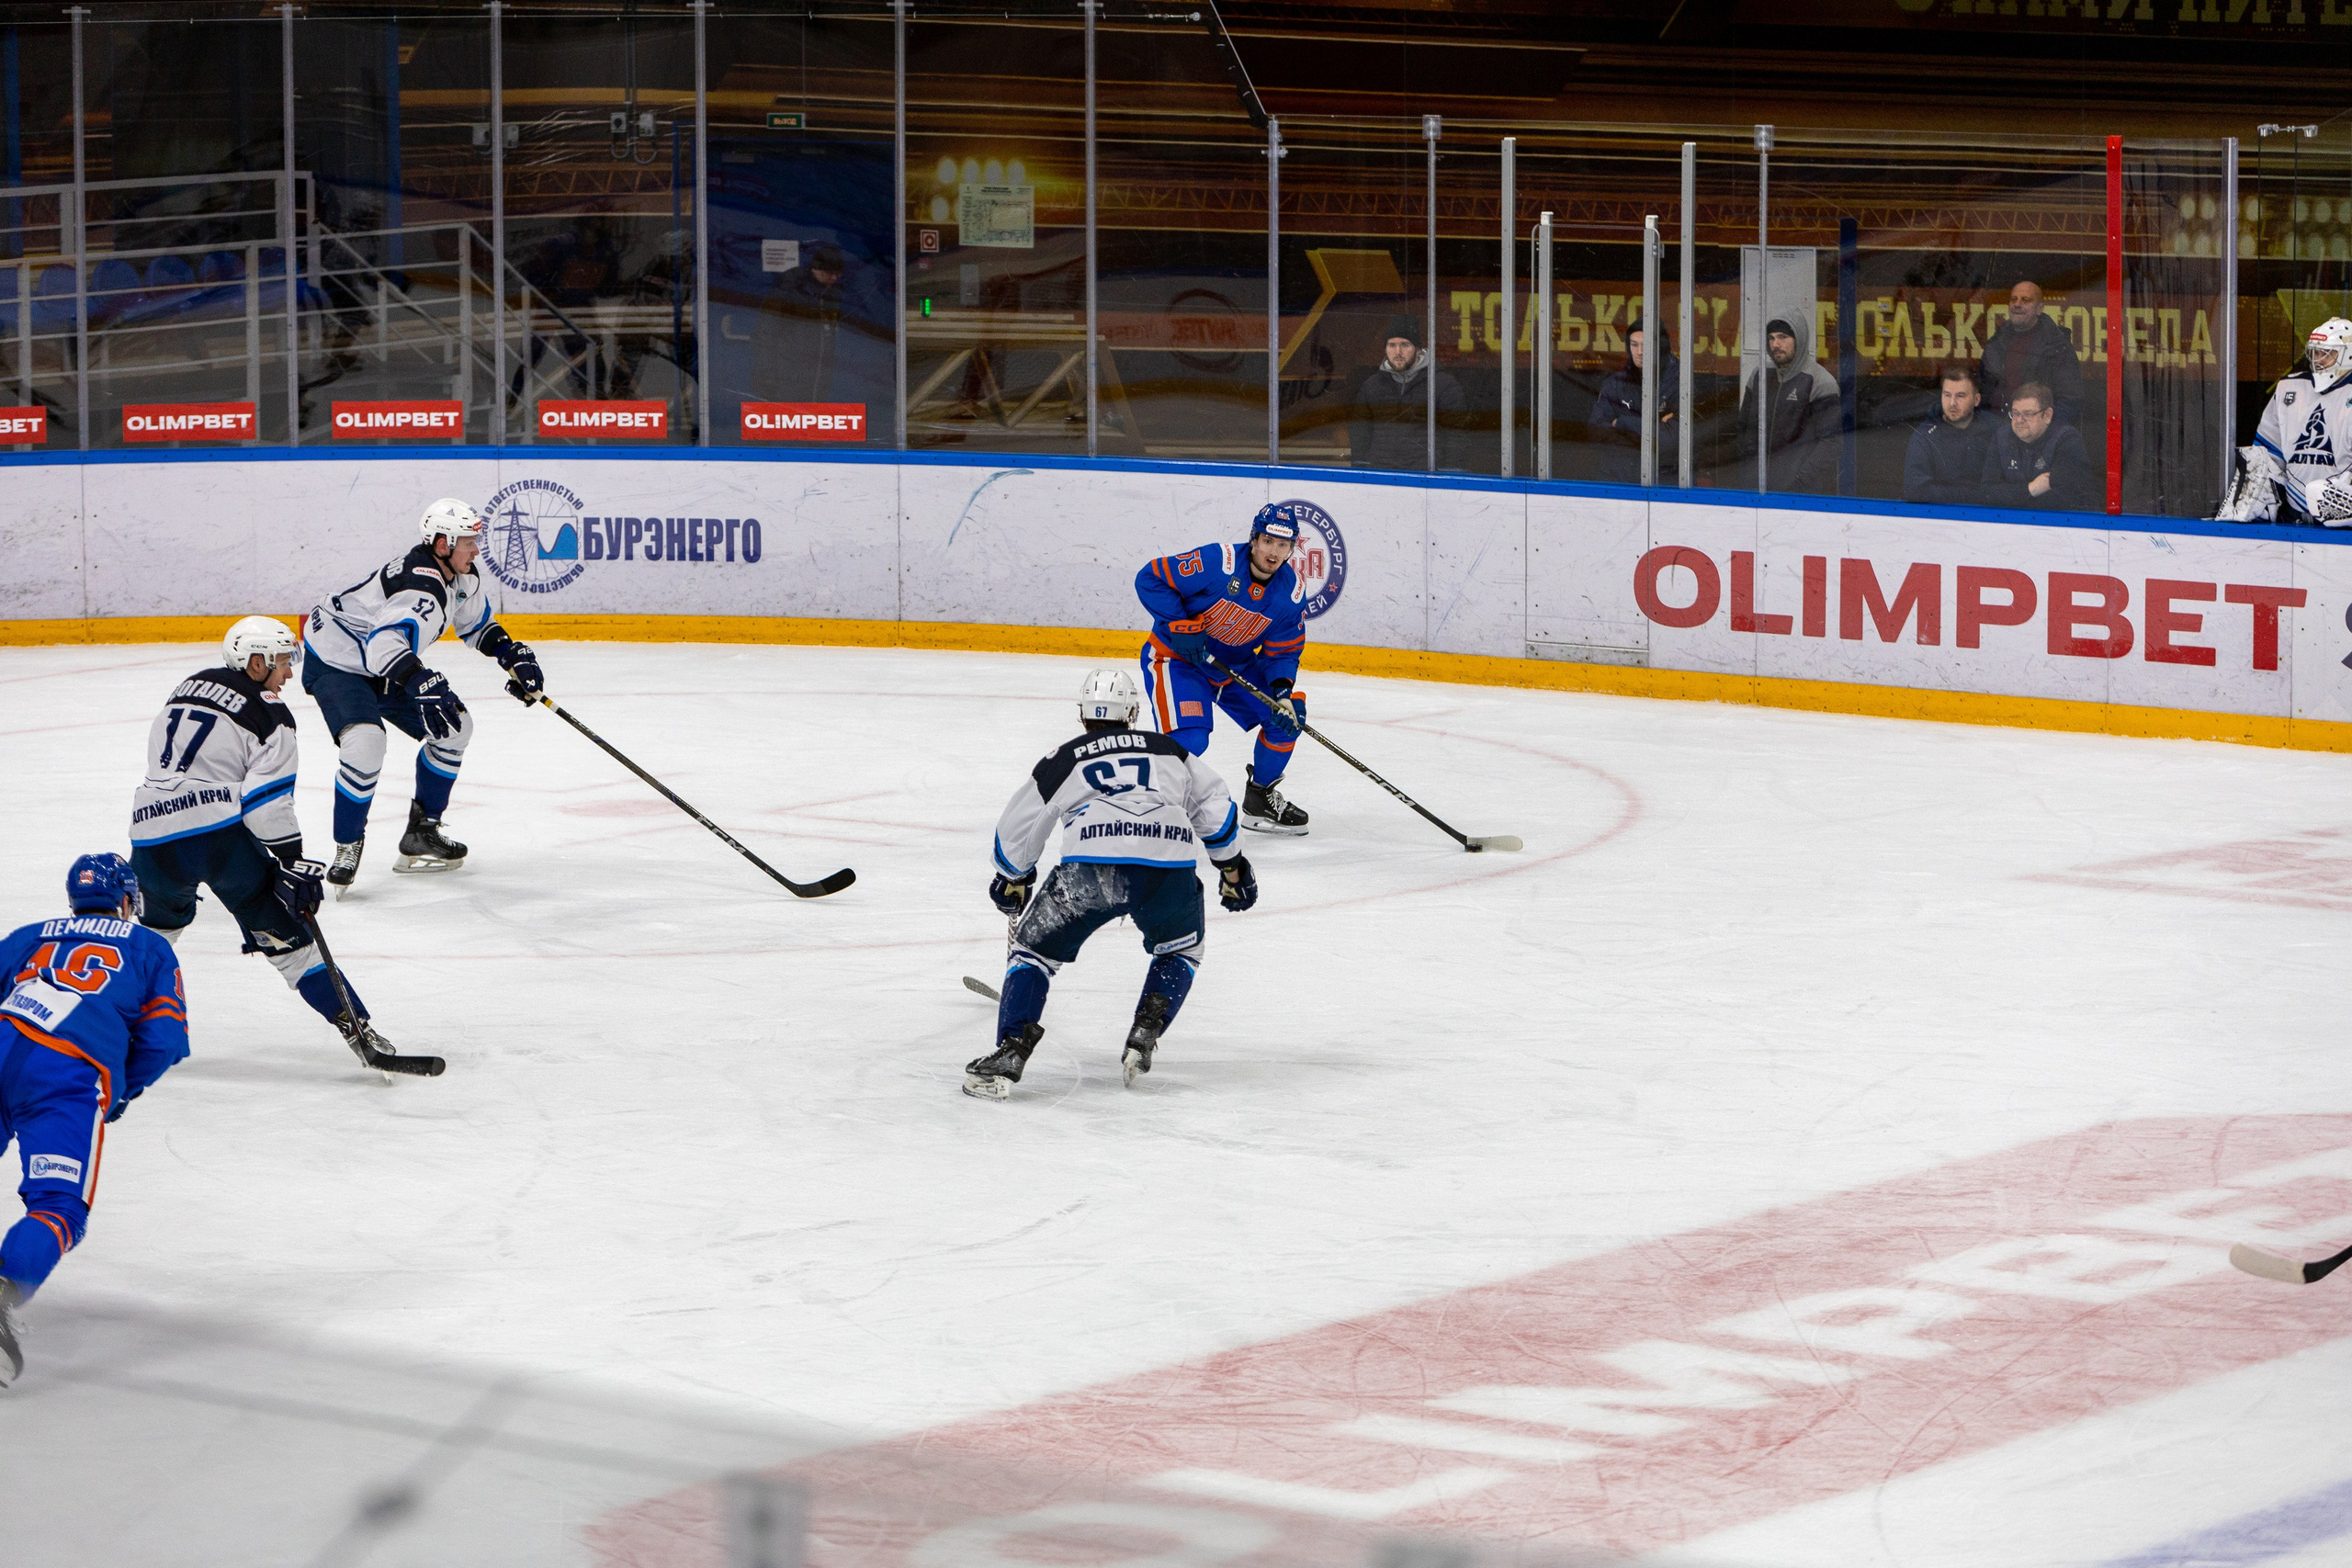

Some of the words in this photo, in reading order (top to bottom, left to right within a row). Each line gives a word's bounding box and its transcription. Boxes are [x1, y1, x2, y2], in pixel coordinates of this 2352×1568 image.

[0, 418, 42, 434] BET
[126, 412, 253, 431] OLIMPBET
[335, 412, 459, 428] OLIMPBET
[541, 412, 663, 428] OLIMPBET
[744, 413, 863, 431] OLIMPBET
[2288, 453, 2336, 468] АЛТАЙ
[484, 479, 584, 515] ОТВЕТСТВЕННОСТЬЮ
[583, 517, 762, 563] БУРЭНЕРГО
[1283, 504, 1344, 576] ЕТЕРБУРГ
[529, 563, 584, 593] ОБЩЕСТВО
[412, 597, 435, 622] 52
[1634, 545, 2308, 671] OLIMPBET
[167, 679, 248, 714] ОГАЛЕВ
[1095, 706, 1108, 718] 67
[160, 707, 219, 773] 17
[1073, 734, 1147, 759] РЕМОВ
[1081, 757, 1159, 796] 67
[1363, 771, 1416, 807] CCM
[133, 790, 198, 825] АЛТАЙСКИЙ
[199, 786, 232, 806] КРАЙ
[1080, 819, 1161, 841] АЛТАЙСКИЙ
[1164, 822, 1193, 844] КРАЙ
[40, 919, 134, 938] ДЕМИДОВ
[14, 942, 124, 995] 16
